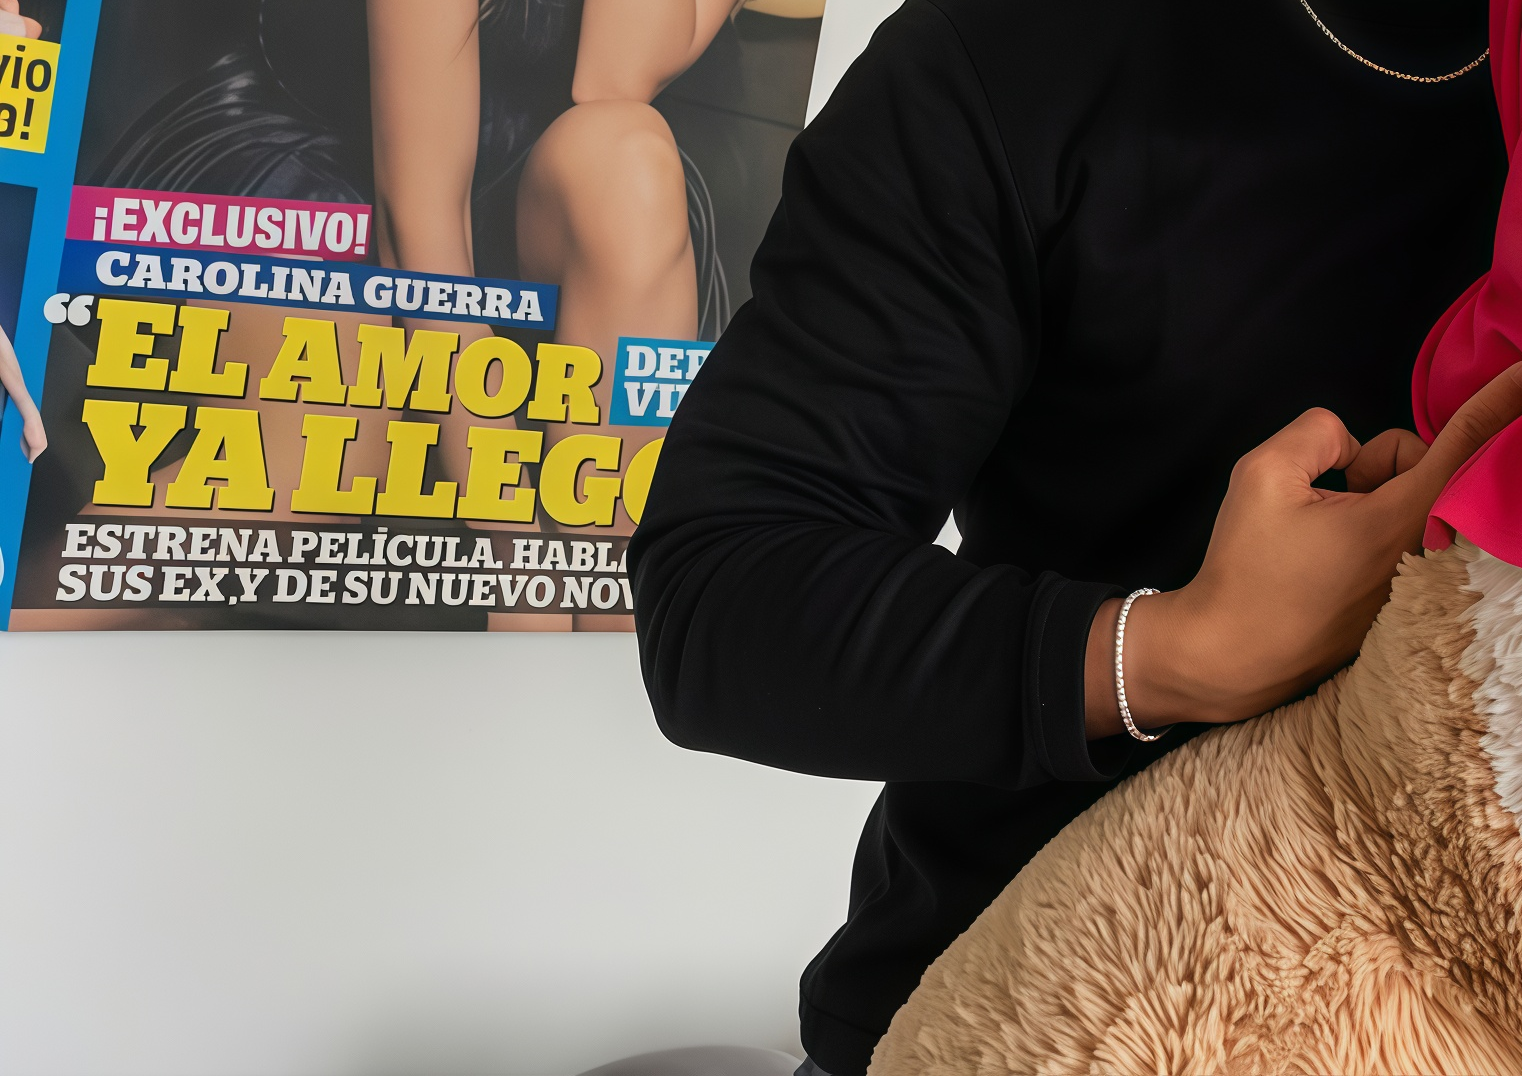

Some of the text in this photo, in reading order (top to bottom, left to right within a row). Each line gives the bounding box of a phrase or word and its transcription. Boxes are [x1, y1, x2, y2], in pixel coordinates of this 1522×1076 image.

[92, 197, 369, 255] ¡EXCLUSIVO!
[95, 250, 544, 322] CAROLINA GUERRA
[258, 316, 603, 424] AMOR
[624, 381, 690, 418] VI
[81, 399, 275, 511] YA
[61, 523, 283, 563] ESTRENA
[55, 564, 154, 602] SUS
[272, 568, 338, 604] DE
[341, 570, 403, 605] SU
[404, 572, 556, 608] NUEVO
